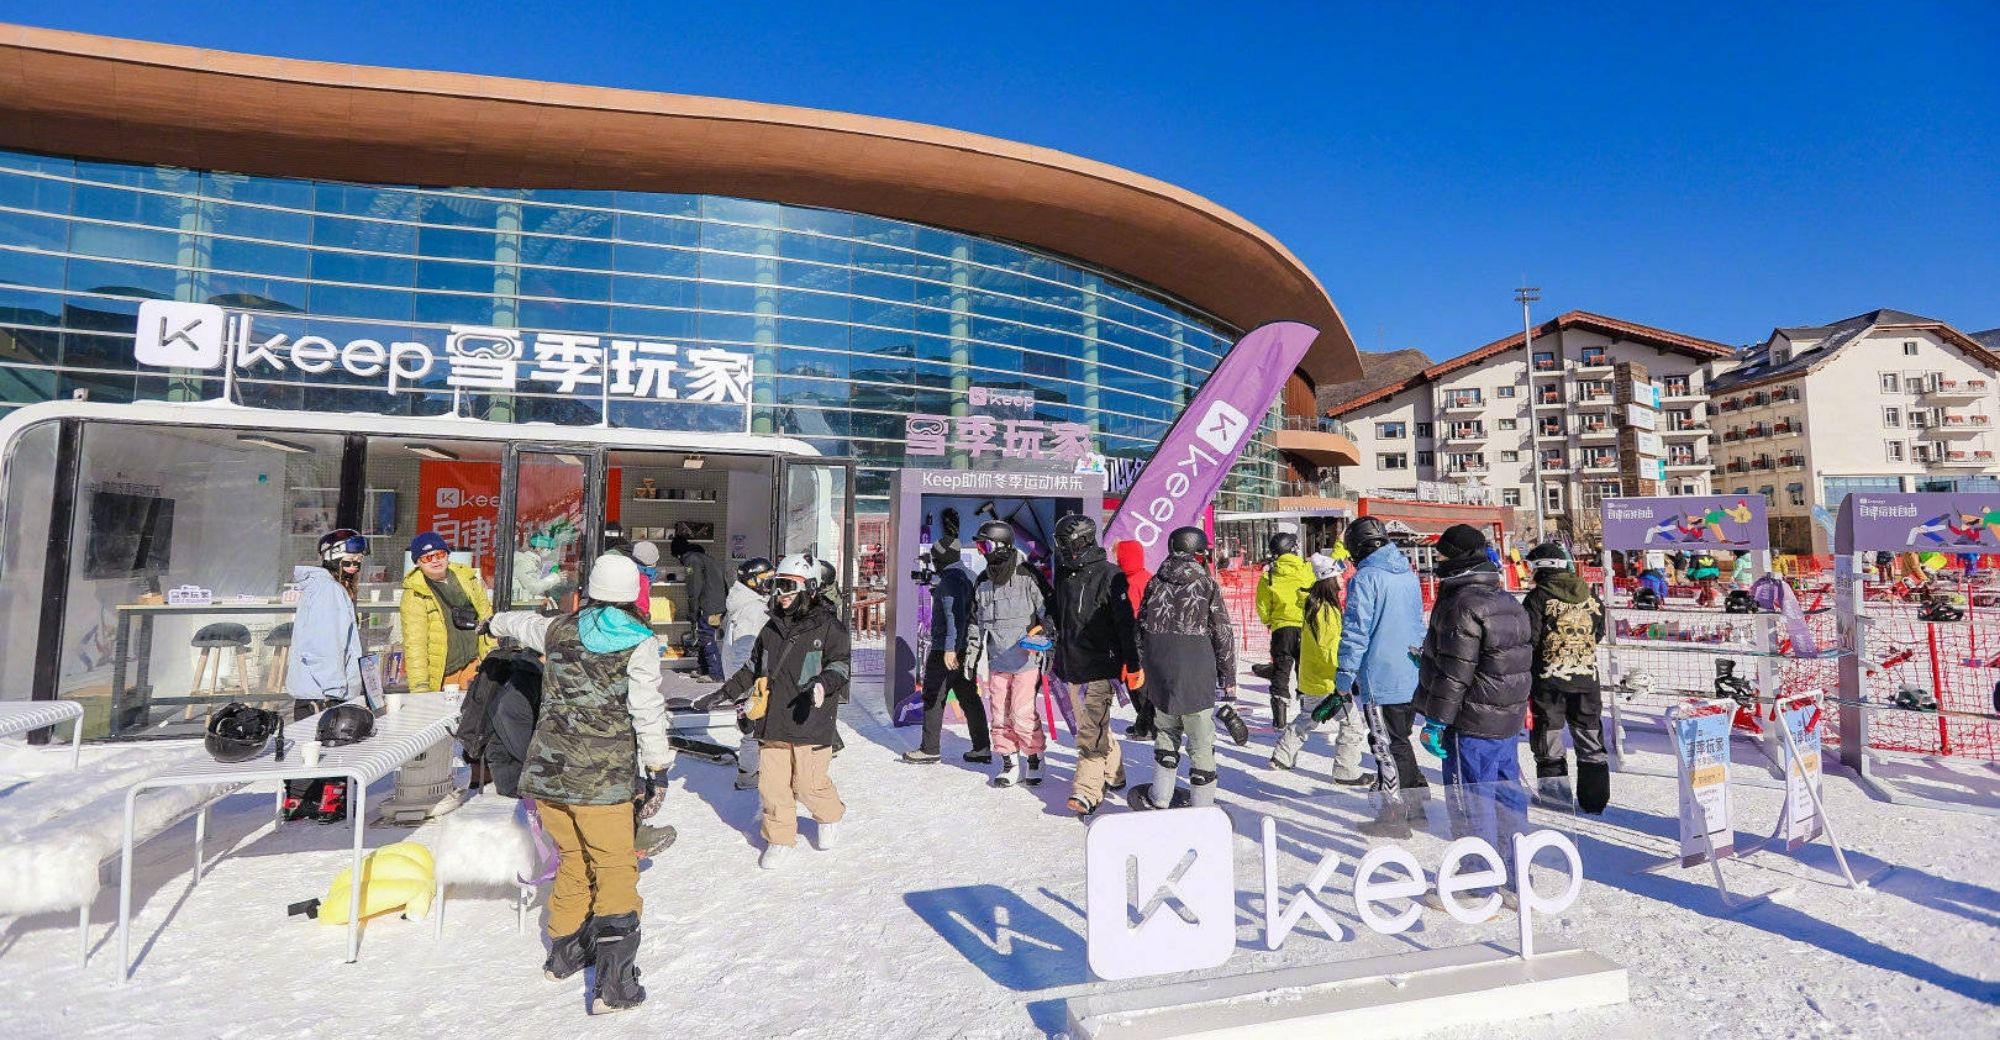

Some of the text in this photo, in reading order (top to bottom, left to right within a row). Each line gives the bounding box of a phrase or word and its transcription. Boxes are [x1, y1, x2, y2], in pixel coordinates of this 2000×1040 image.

[236, 313, 435, 396] keep
[989, 388, 1035, 412] keep
[461, 490, 501, 507] kee
[922, 472, 1085, 492] Keep助你冬季运动快乐
[1130, 443, 1218, 547] keep
[1260, 815, 1584, 960] keep
